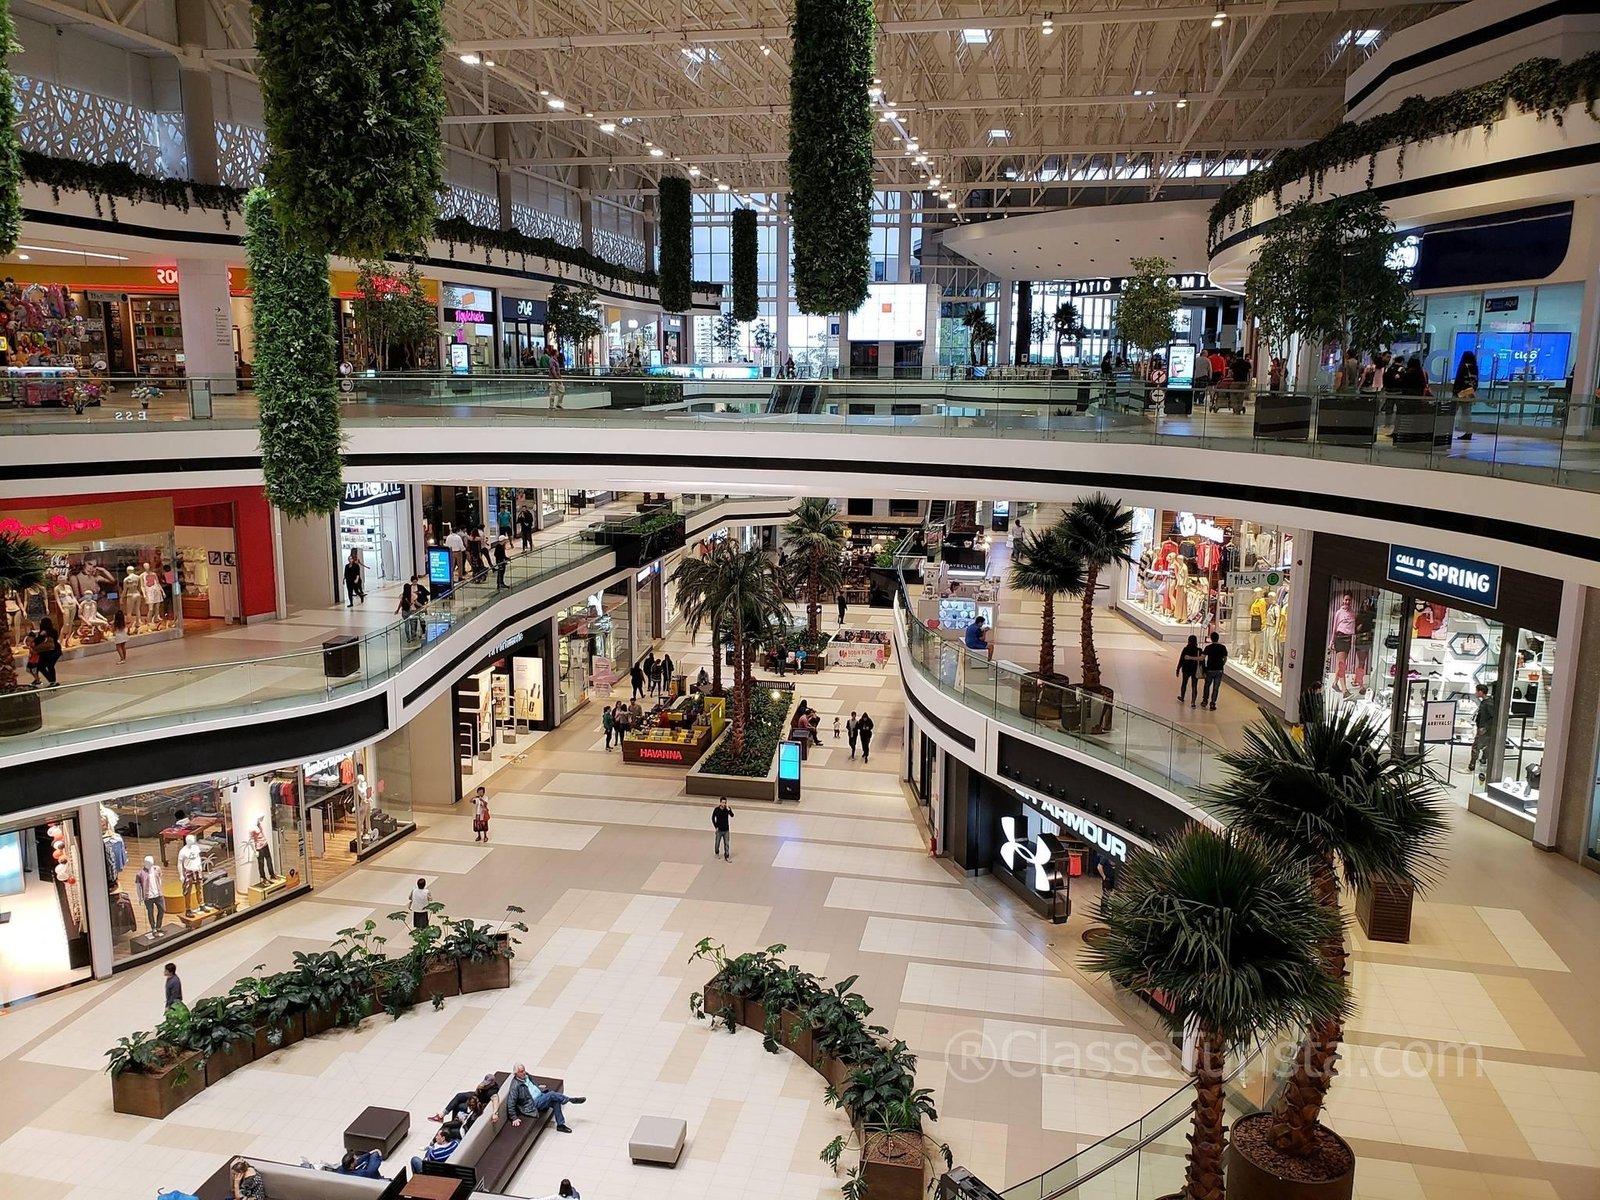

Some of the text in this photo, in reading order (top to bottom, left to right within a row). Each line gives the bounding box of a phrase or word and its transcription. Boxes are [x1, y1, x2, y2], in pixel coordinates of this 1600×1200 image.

[1075, 280, 1111, 293] PATIO
[1514, 349, 1540, 363] tigo
[1396, 554, 1490, 593] CALL IT SPRING
[640, 749, 682, 760] HAVANNA
[1041, 801, 1127, 863] ARMOUR
